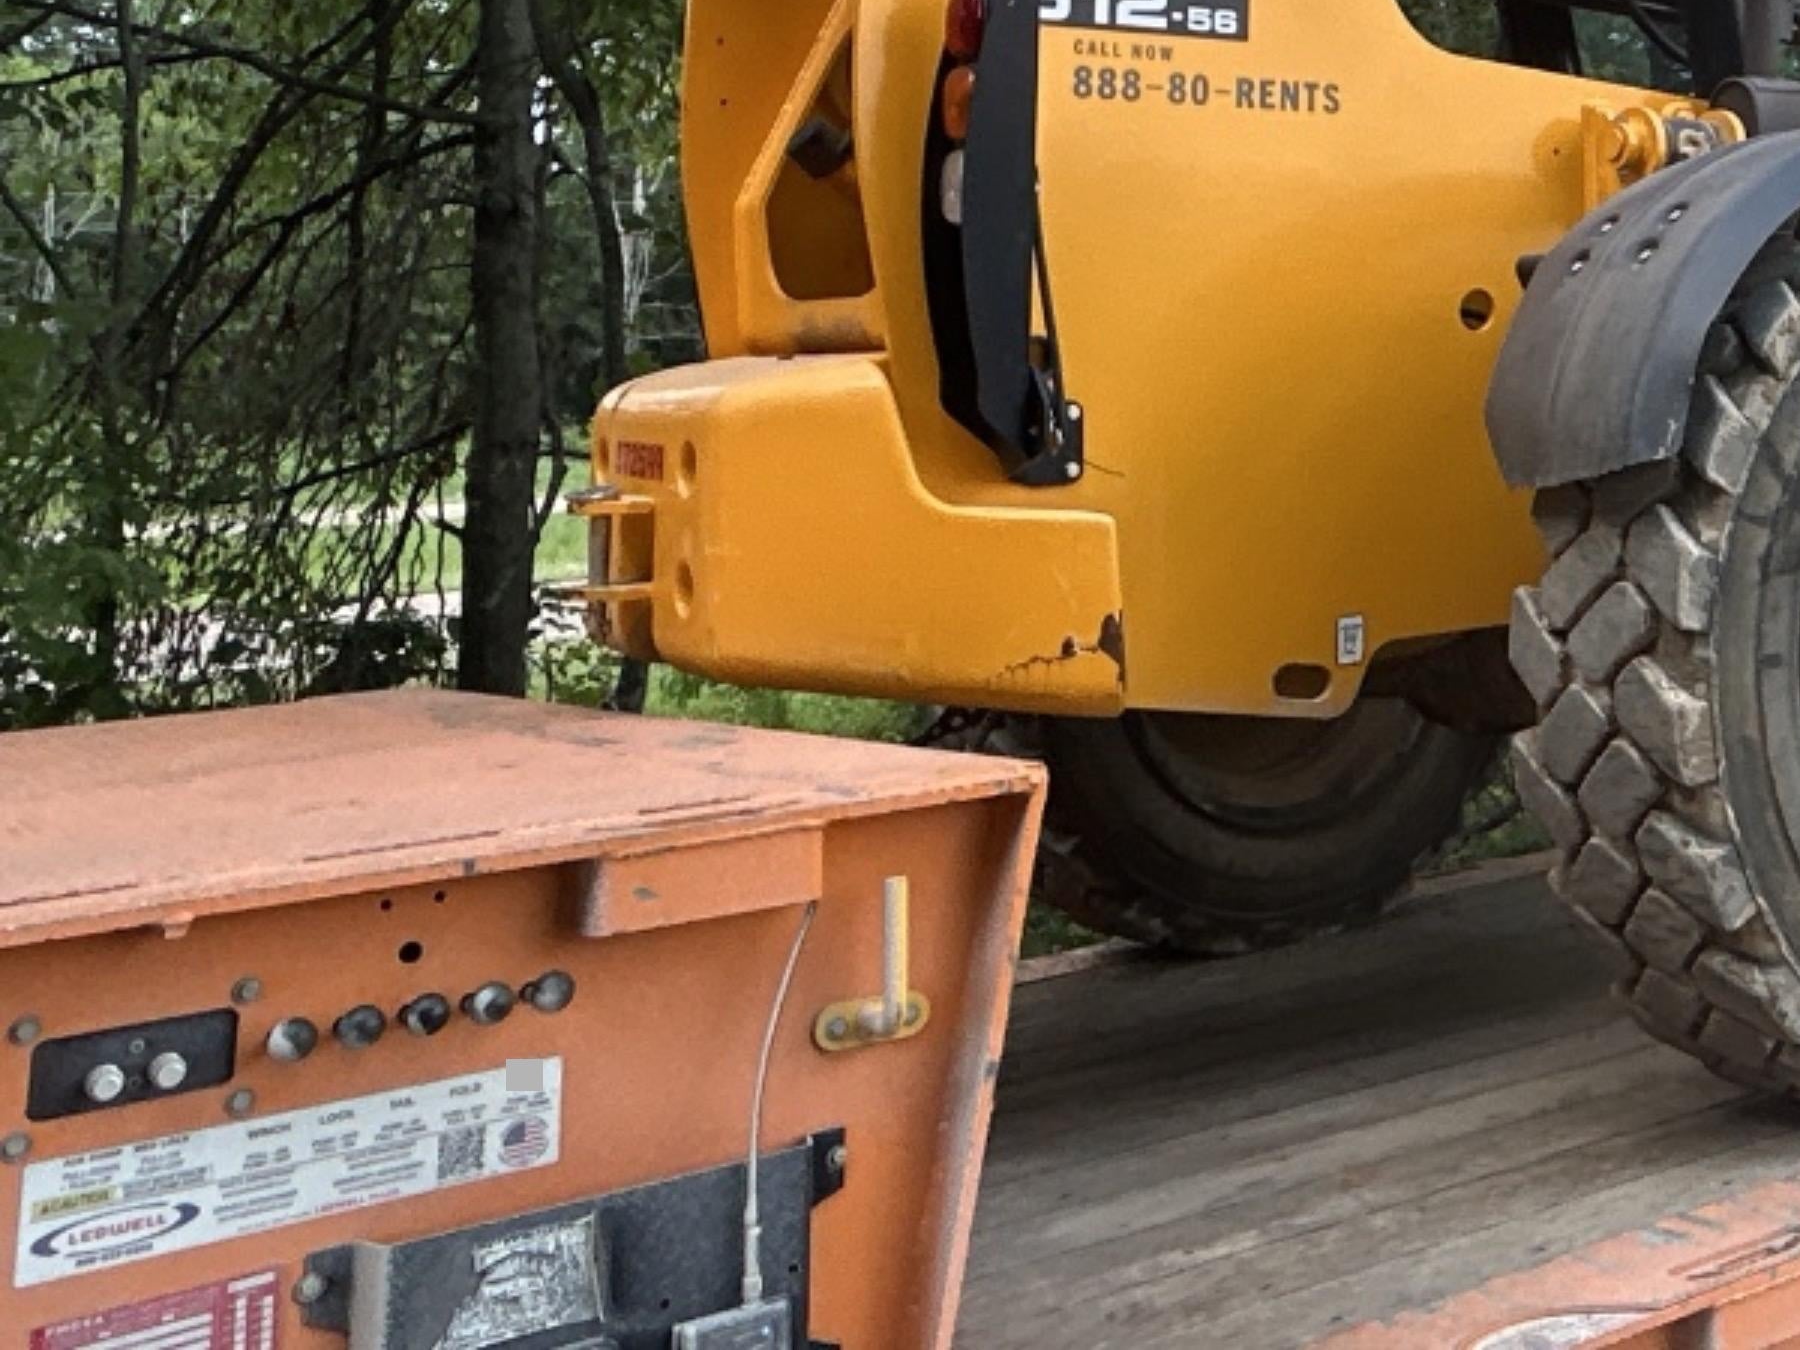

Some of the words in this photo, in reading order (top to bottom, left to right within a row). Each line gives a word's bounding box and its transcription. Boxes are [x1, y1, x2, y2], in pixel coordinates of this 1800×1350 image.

[1073, 38, 1122, 58] CALL
[1131, 43, 1174, 62] NOW
[1073, 65, 1341, 115] 888-80-RENTS
